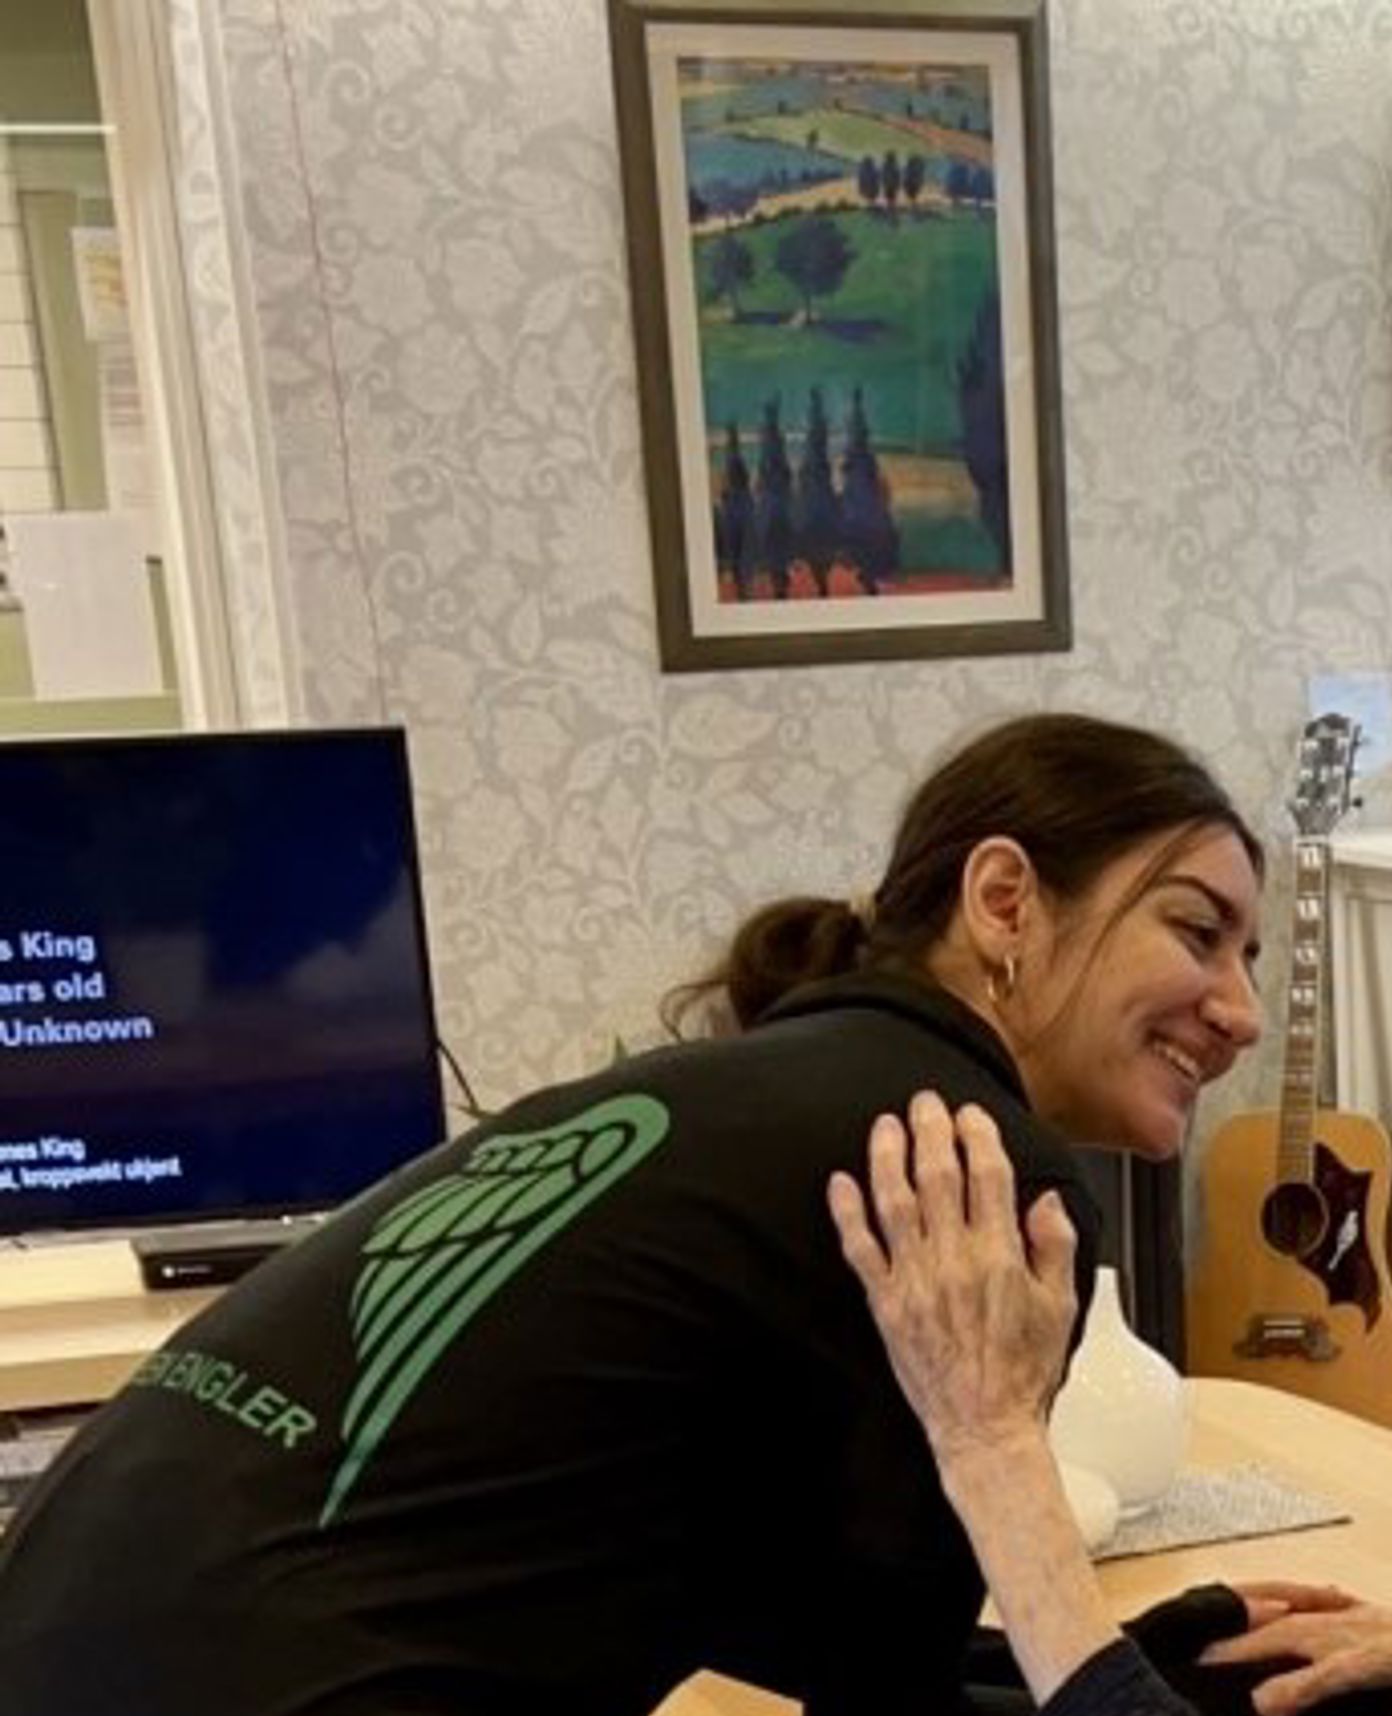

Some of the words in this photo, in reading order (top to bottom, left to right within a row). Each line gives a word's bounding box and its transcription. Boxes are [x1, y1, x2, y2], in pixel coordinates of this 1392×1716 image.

[20, 930, 96, 964] King
[53, 971, 105, 1001] old
[0, 1016, 154, 1047] Unknown
